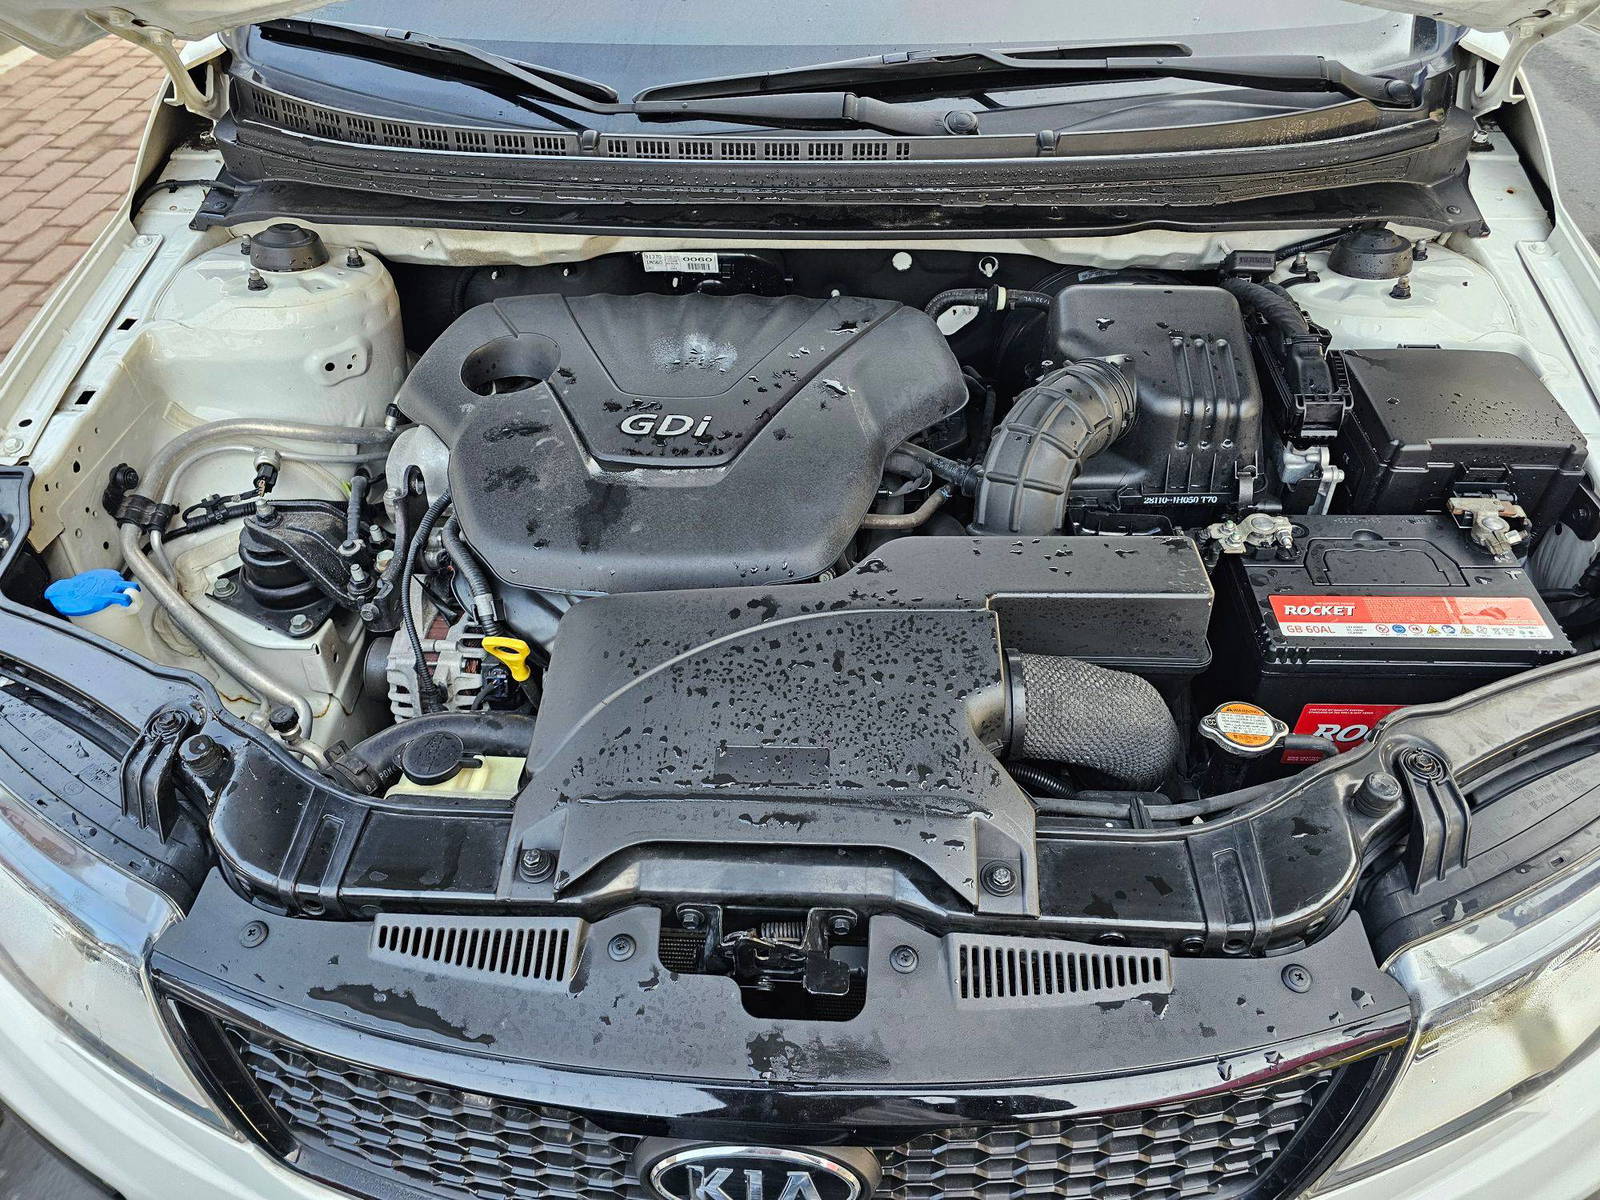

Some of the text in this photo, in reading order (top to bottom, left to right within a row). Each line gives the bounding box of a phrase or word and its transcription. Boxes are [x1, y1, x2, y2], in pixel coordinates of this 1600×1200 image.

[620, 413, 713, 437] GDi
[1143, 495, 1218, 505] 28110-1H050 T70
[1284, 605, 1355, 616] ROCKET
[1286, 625, 1303, 633] GB
[1305, 625, 1336, 634] 60AL
[685, 1164, 822, 1200] KIA
